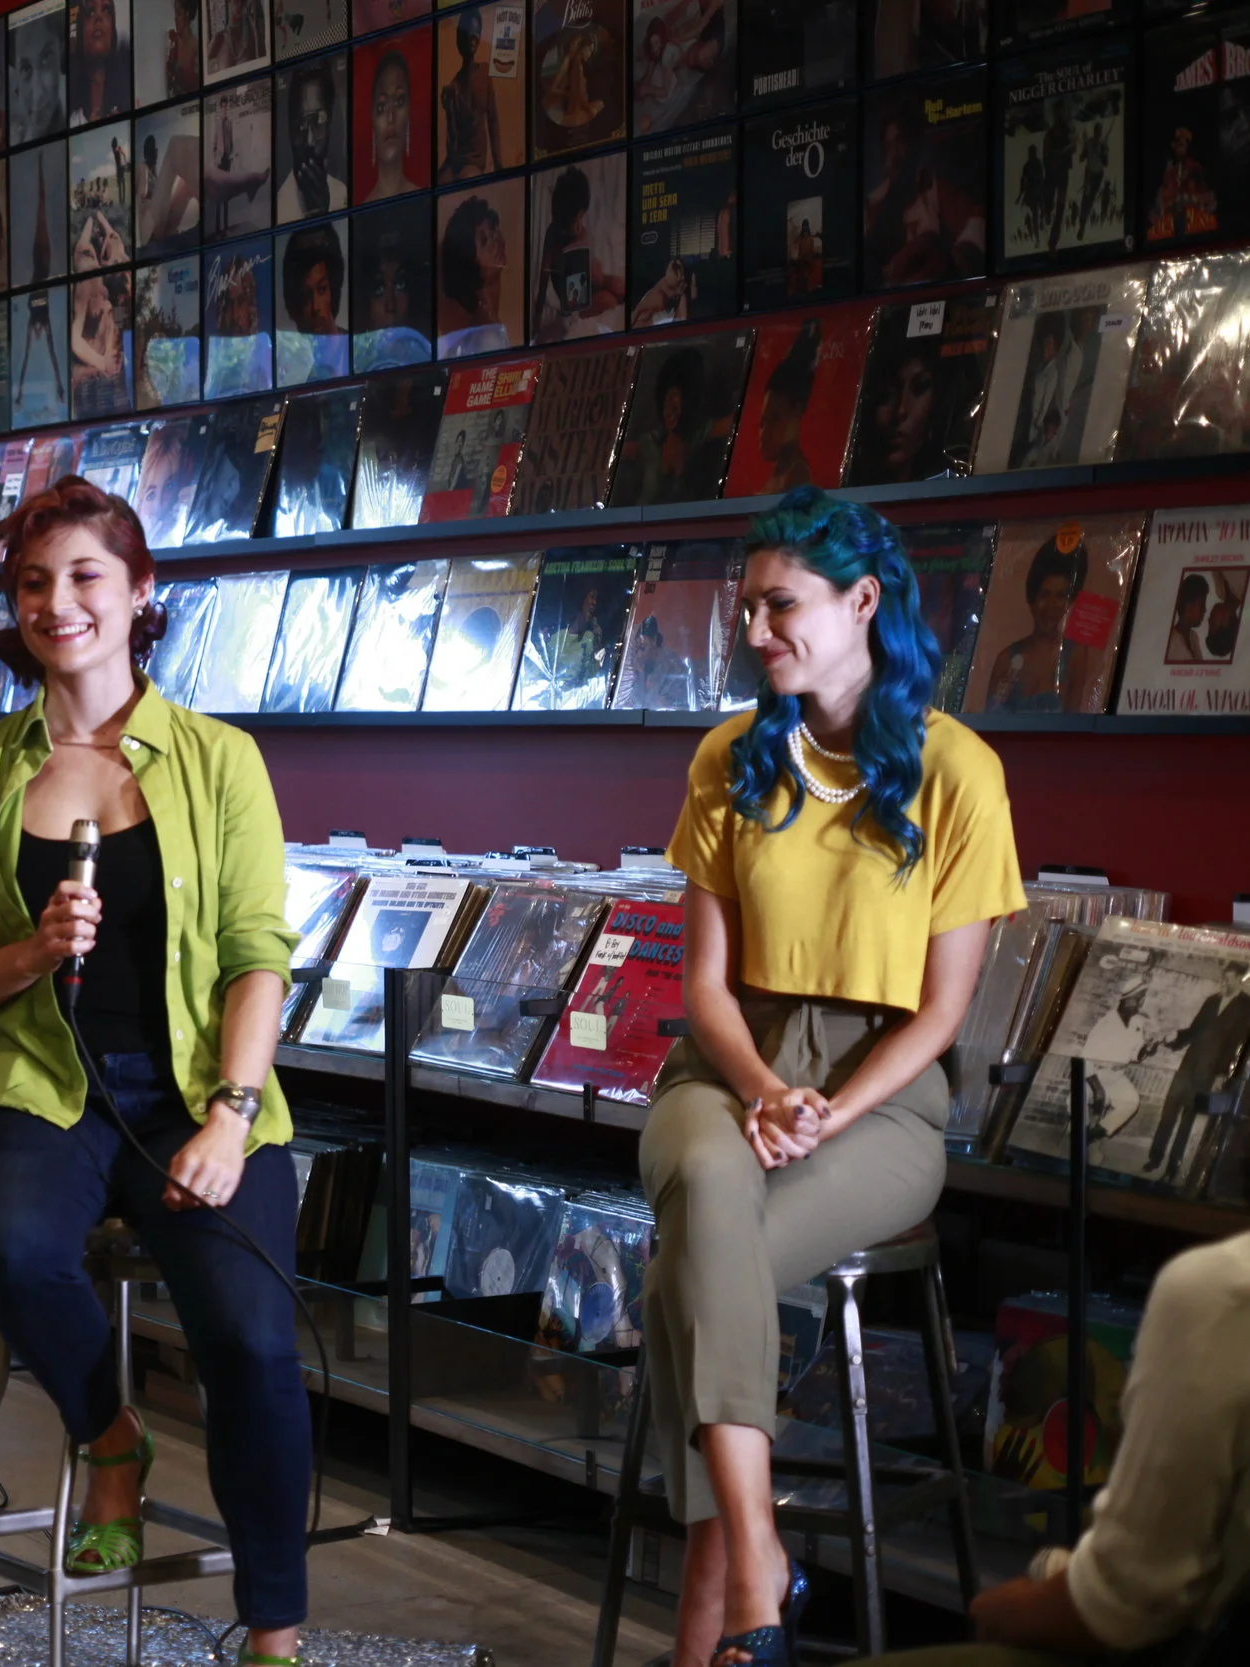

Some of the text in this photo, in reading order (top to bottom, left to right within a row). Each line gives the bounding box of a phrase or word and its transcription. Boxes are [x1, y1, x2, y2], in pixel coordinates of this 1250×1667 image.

[1174, 49, 1215, 92] JAMES
[772, 121, 831, 150] Geschichte
[786, 142, 825, 178] der O
[481, 367, 498, 381] THE
[469, 380, 495, 394] NAME
[466, 393, 492, 408] GAME
[612, 912, 685, 939] DISCO and
[630, 940, 685, 967] DANCES
[445, 1000, 472, 1015] SOUL
[573, 1015, 604, 1031] SOUL
